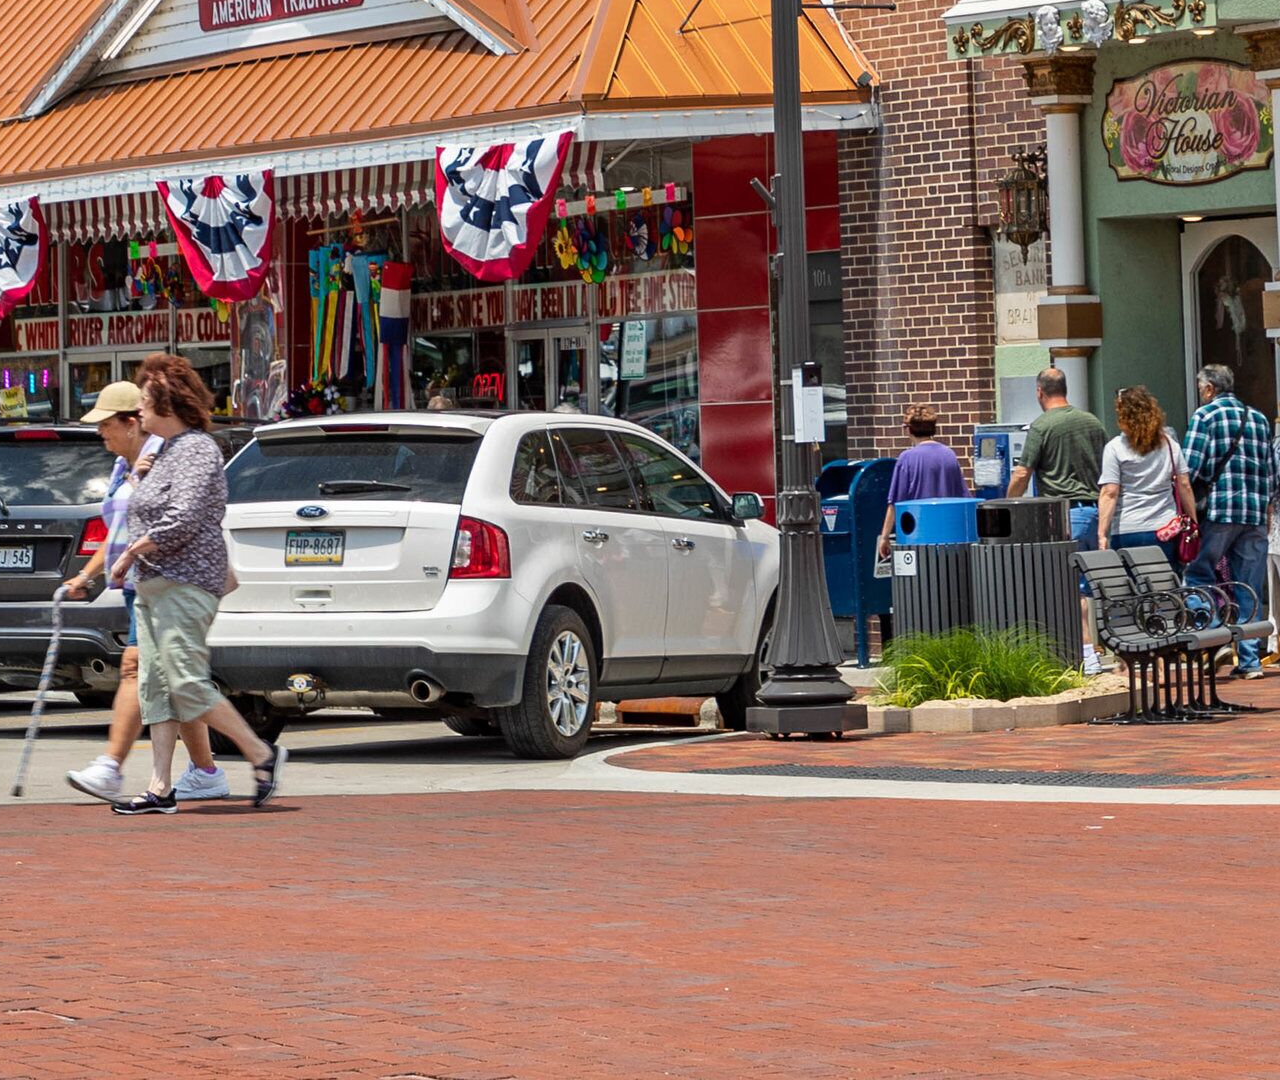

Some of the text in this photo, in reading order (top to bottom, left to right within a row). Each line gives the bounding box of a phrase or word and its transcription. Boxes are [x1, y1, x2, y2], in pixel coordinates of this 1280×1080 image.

[1134, 73, 1238, 118] Victorian
[1146, 117, 1225, 160] House
[456, 292, 483, 328] SINCE
[485, 290, 504, 325] YOU
[513, 288, 538, 322] HAVE
[540, 282, 564, 319] BEEN
[566, 280, 579, 317] IN
[25, 320, 60, 351] WHIT
[70, 311, 194, 348] RIVER ARROWHAD
[472, 372, 507, 402] OPEN
[12, 549, 31, 565] 545
